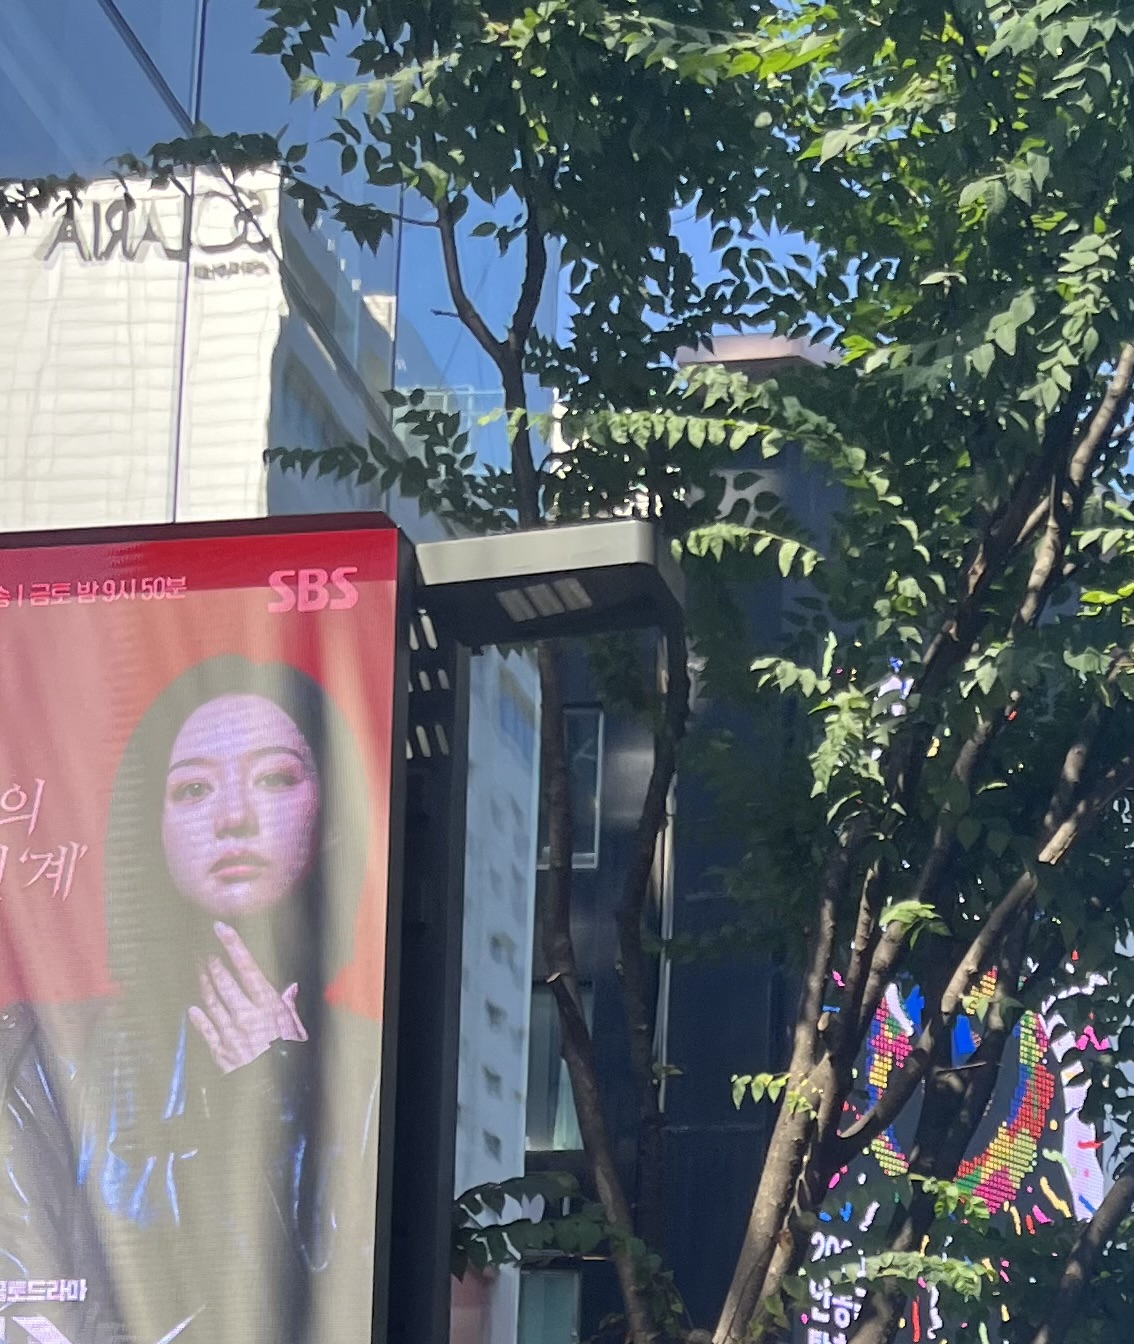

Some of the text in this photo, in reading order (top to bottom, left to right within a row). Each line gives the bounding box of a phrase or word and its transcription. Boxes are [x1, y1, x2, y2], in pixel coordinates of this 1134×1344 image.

[29, 575, 188, 607] 금토 밤 9시 50분
[267, 565, 358, 613] SBS
[0, 1278, 88, 1302] 로드라마
